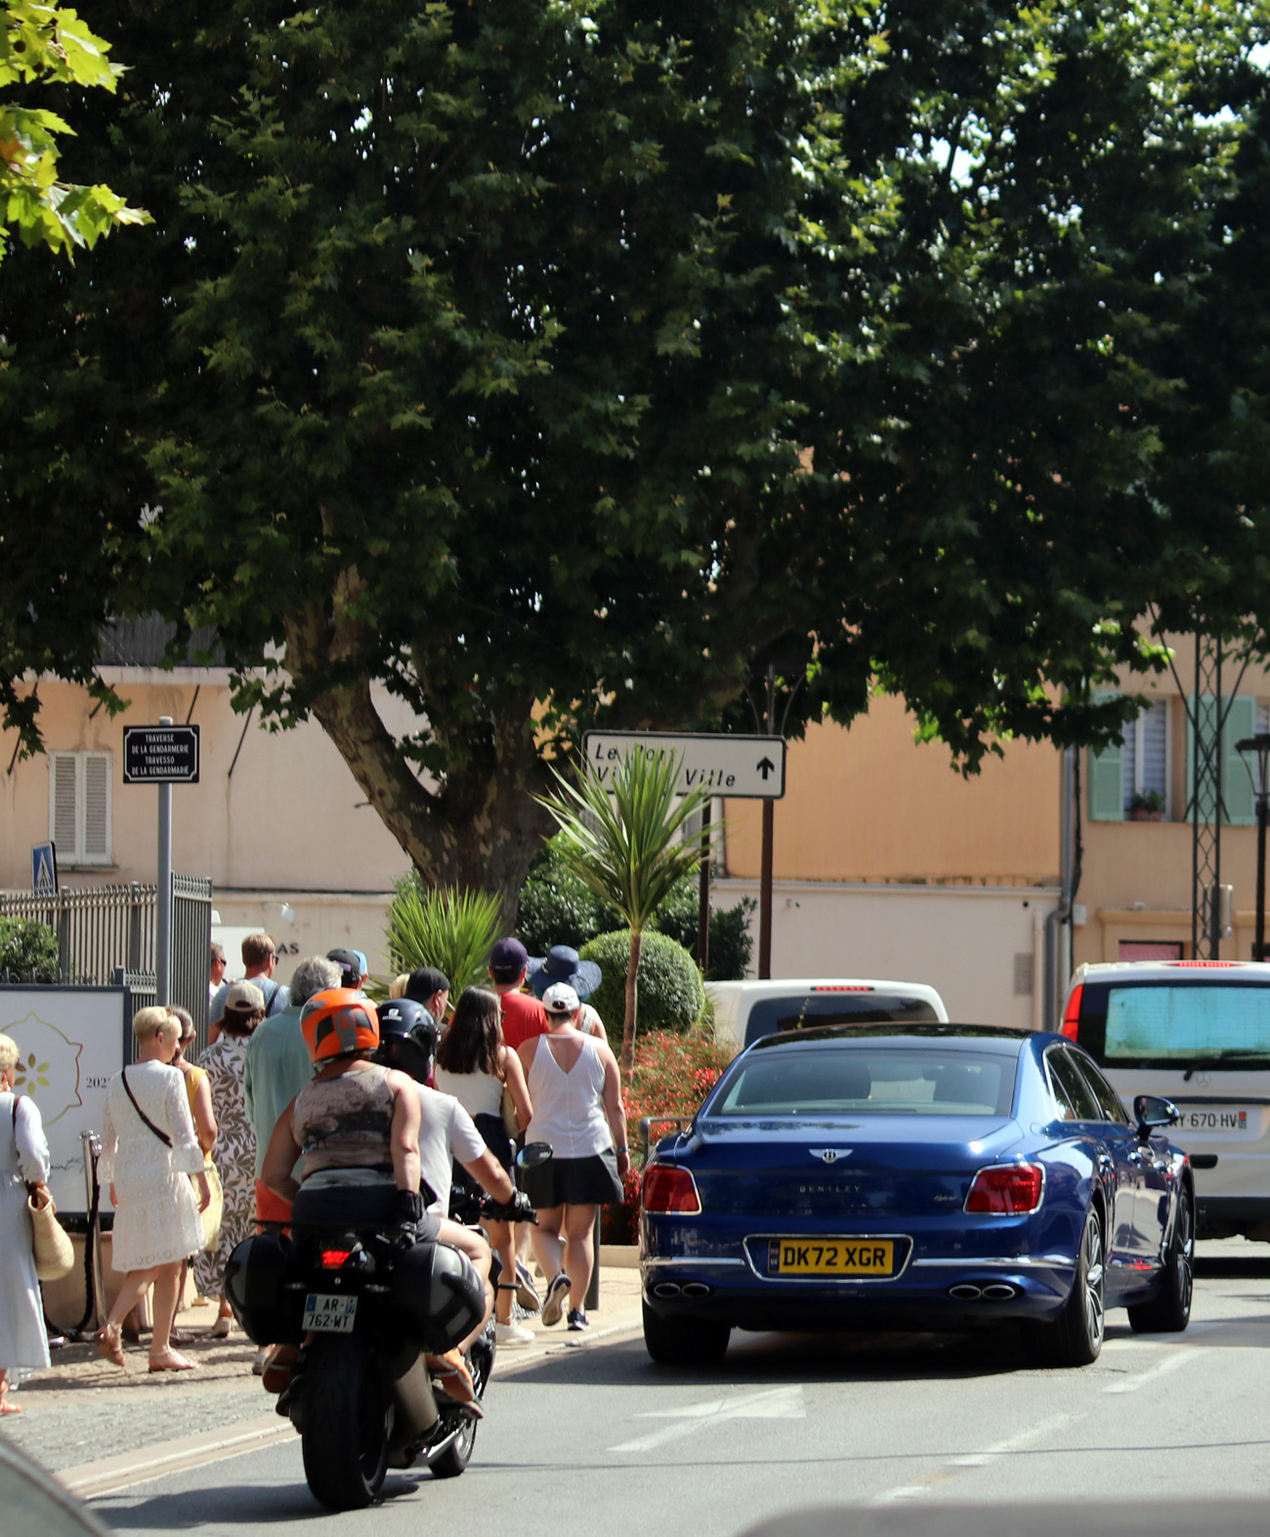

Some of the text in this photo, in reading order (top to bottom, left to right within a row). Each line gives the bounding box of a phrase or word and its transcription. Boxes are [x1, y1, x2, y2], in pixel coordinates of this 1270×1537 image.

[145, 734, 175, 743] TRAVERSE
[131, 744, 189, 754] DE LA GENDARMERIE
[595, 743, 617, 760] Le
[145, 755, 175, 765] TRAVESSO
[131, 766, 139, 775] DE
[140, 766, 148, 775] LA
[685, 768, 736, 787] Ville
[86, 1077, 110, 1088] 202
[783, 1246, 886, 1267] DK72 XGR
